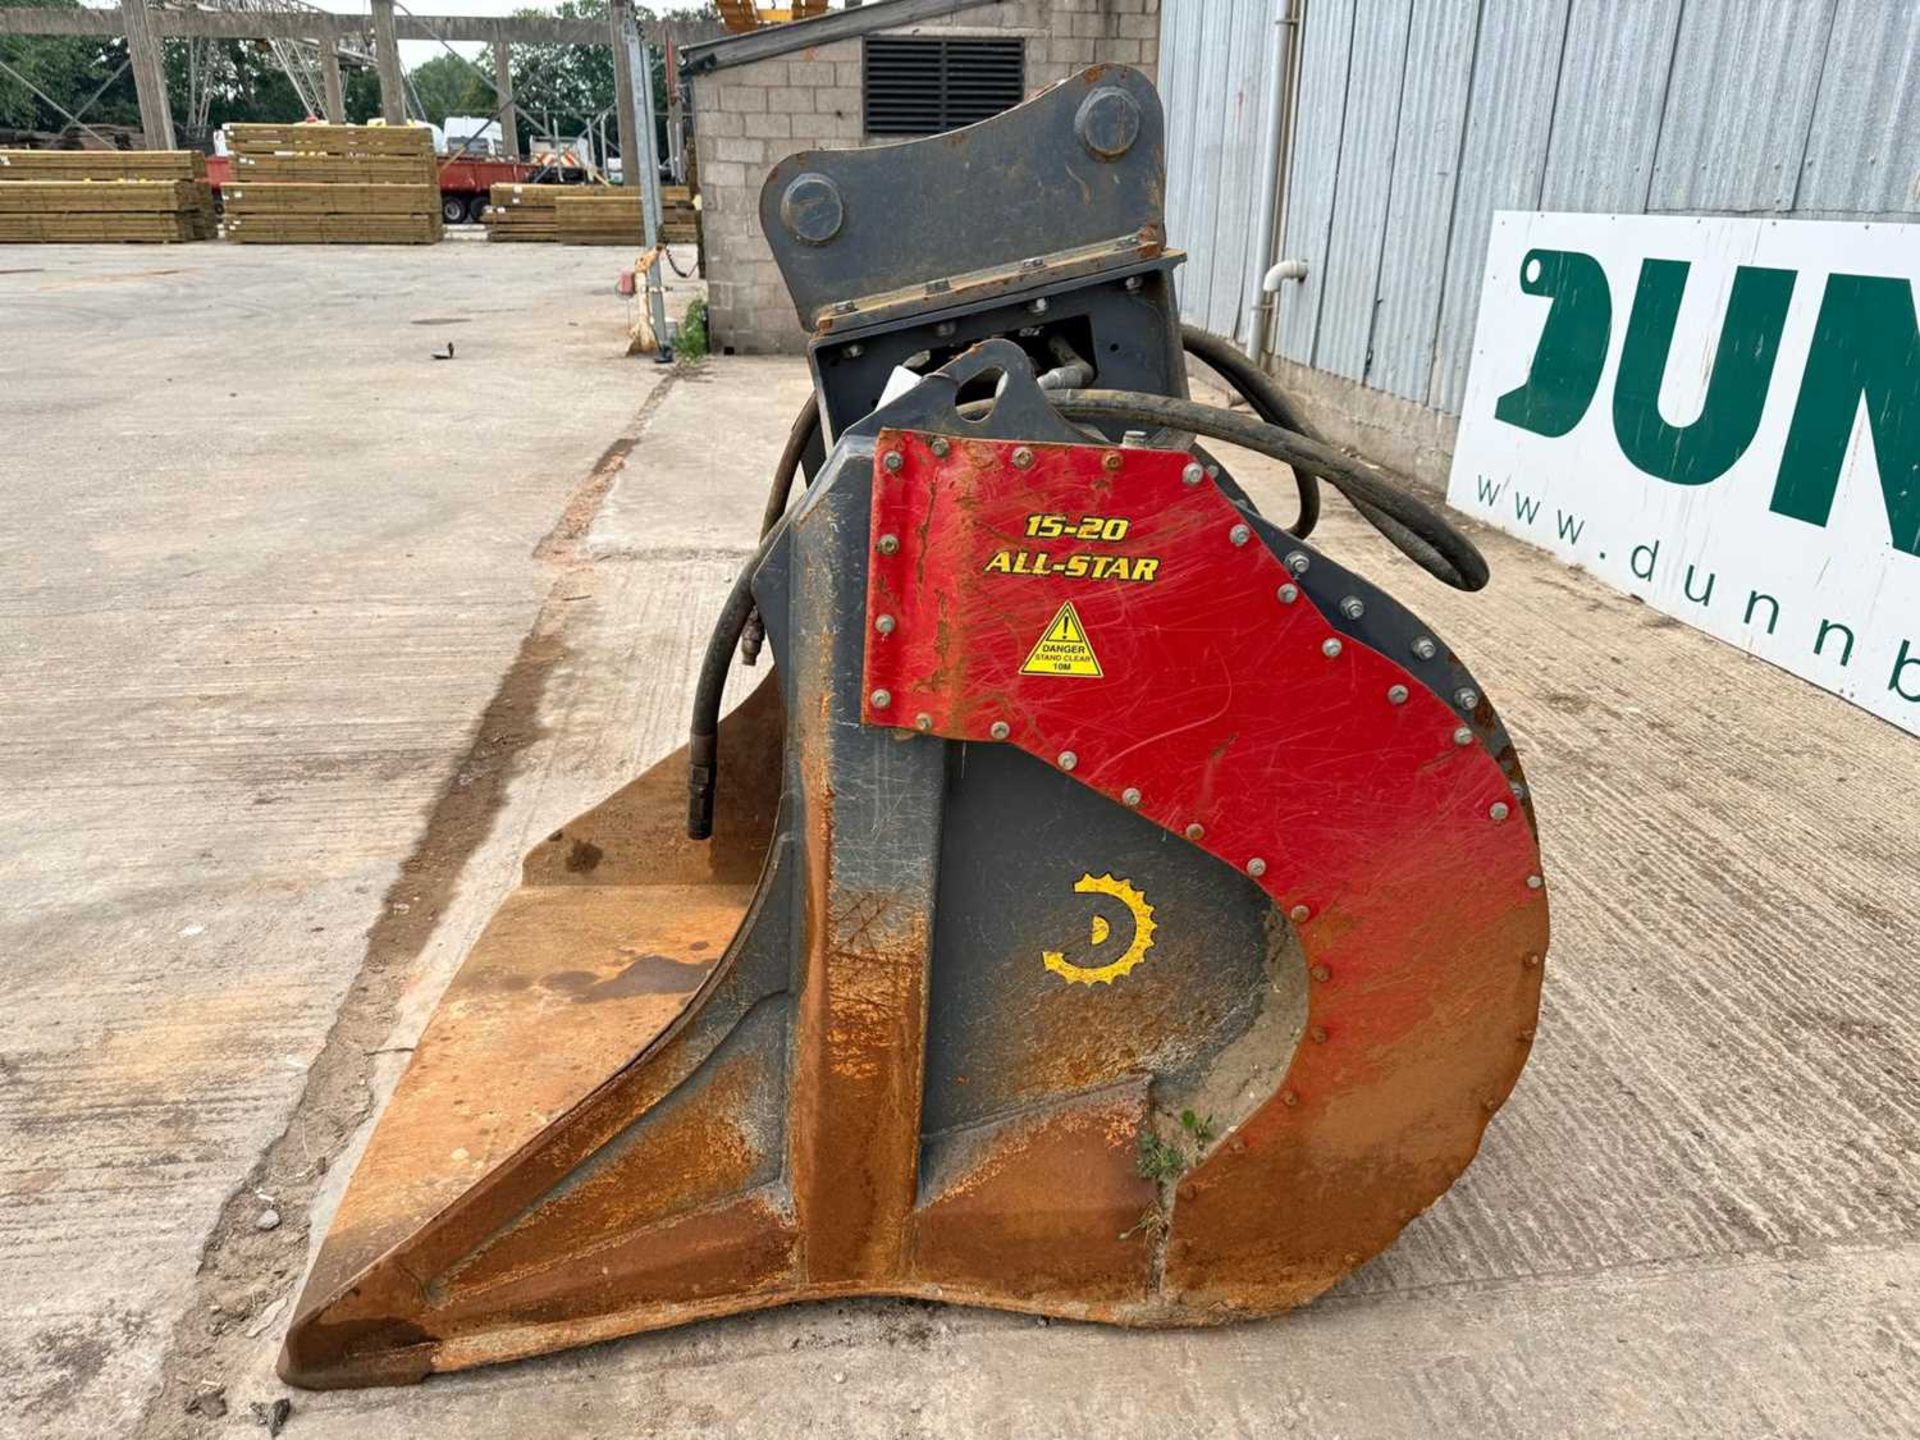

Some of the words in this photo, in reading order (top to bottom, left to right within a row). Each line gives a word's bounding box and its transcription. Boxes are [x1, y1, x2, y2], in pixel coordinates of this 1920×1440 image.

[1026, 514, 1129, 542] 15-20
[984, 551, 1160, 582] ALL-STAR
[1042, 644, 1086, 654] DANGER
[1053, 663, 1071, 671] 10M
